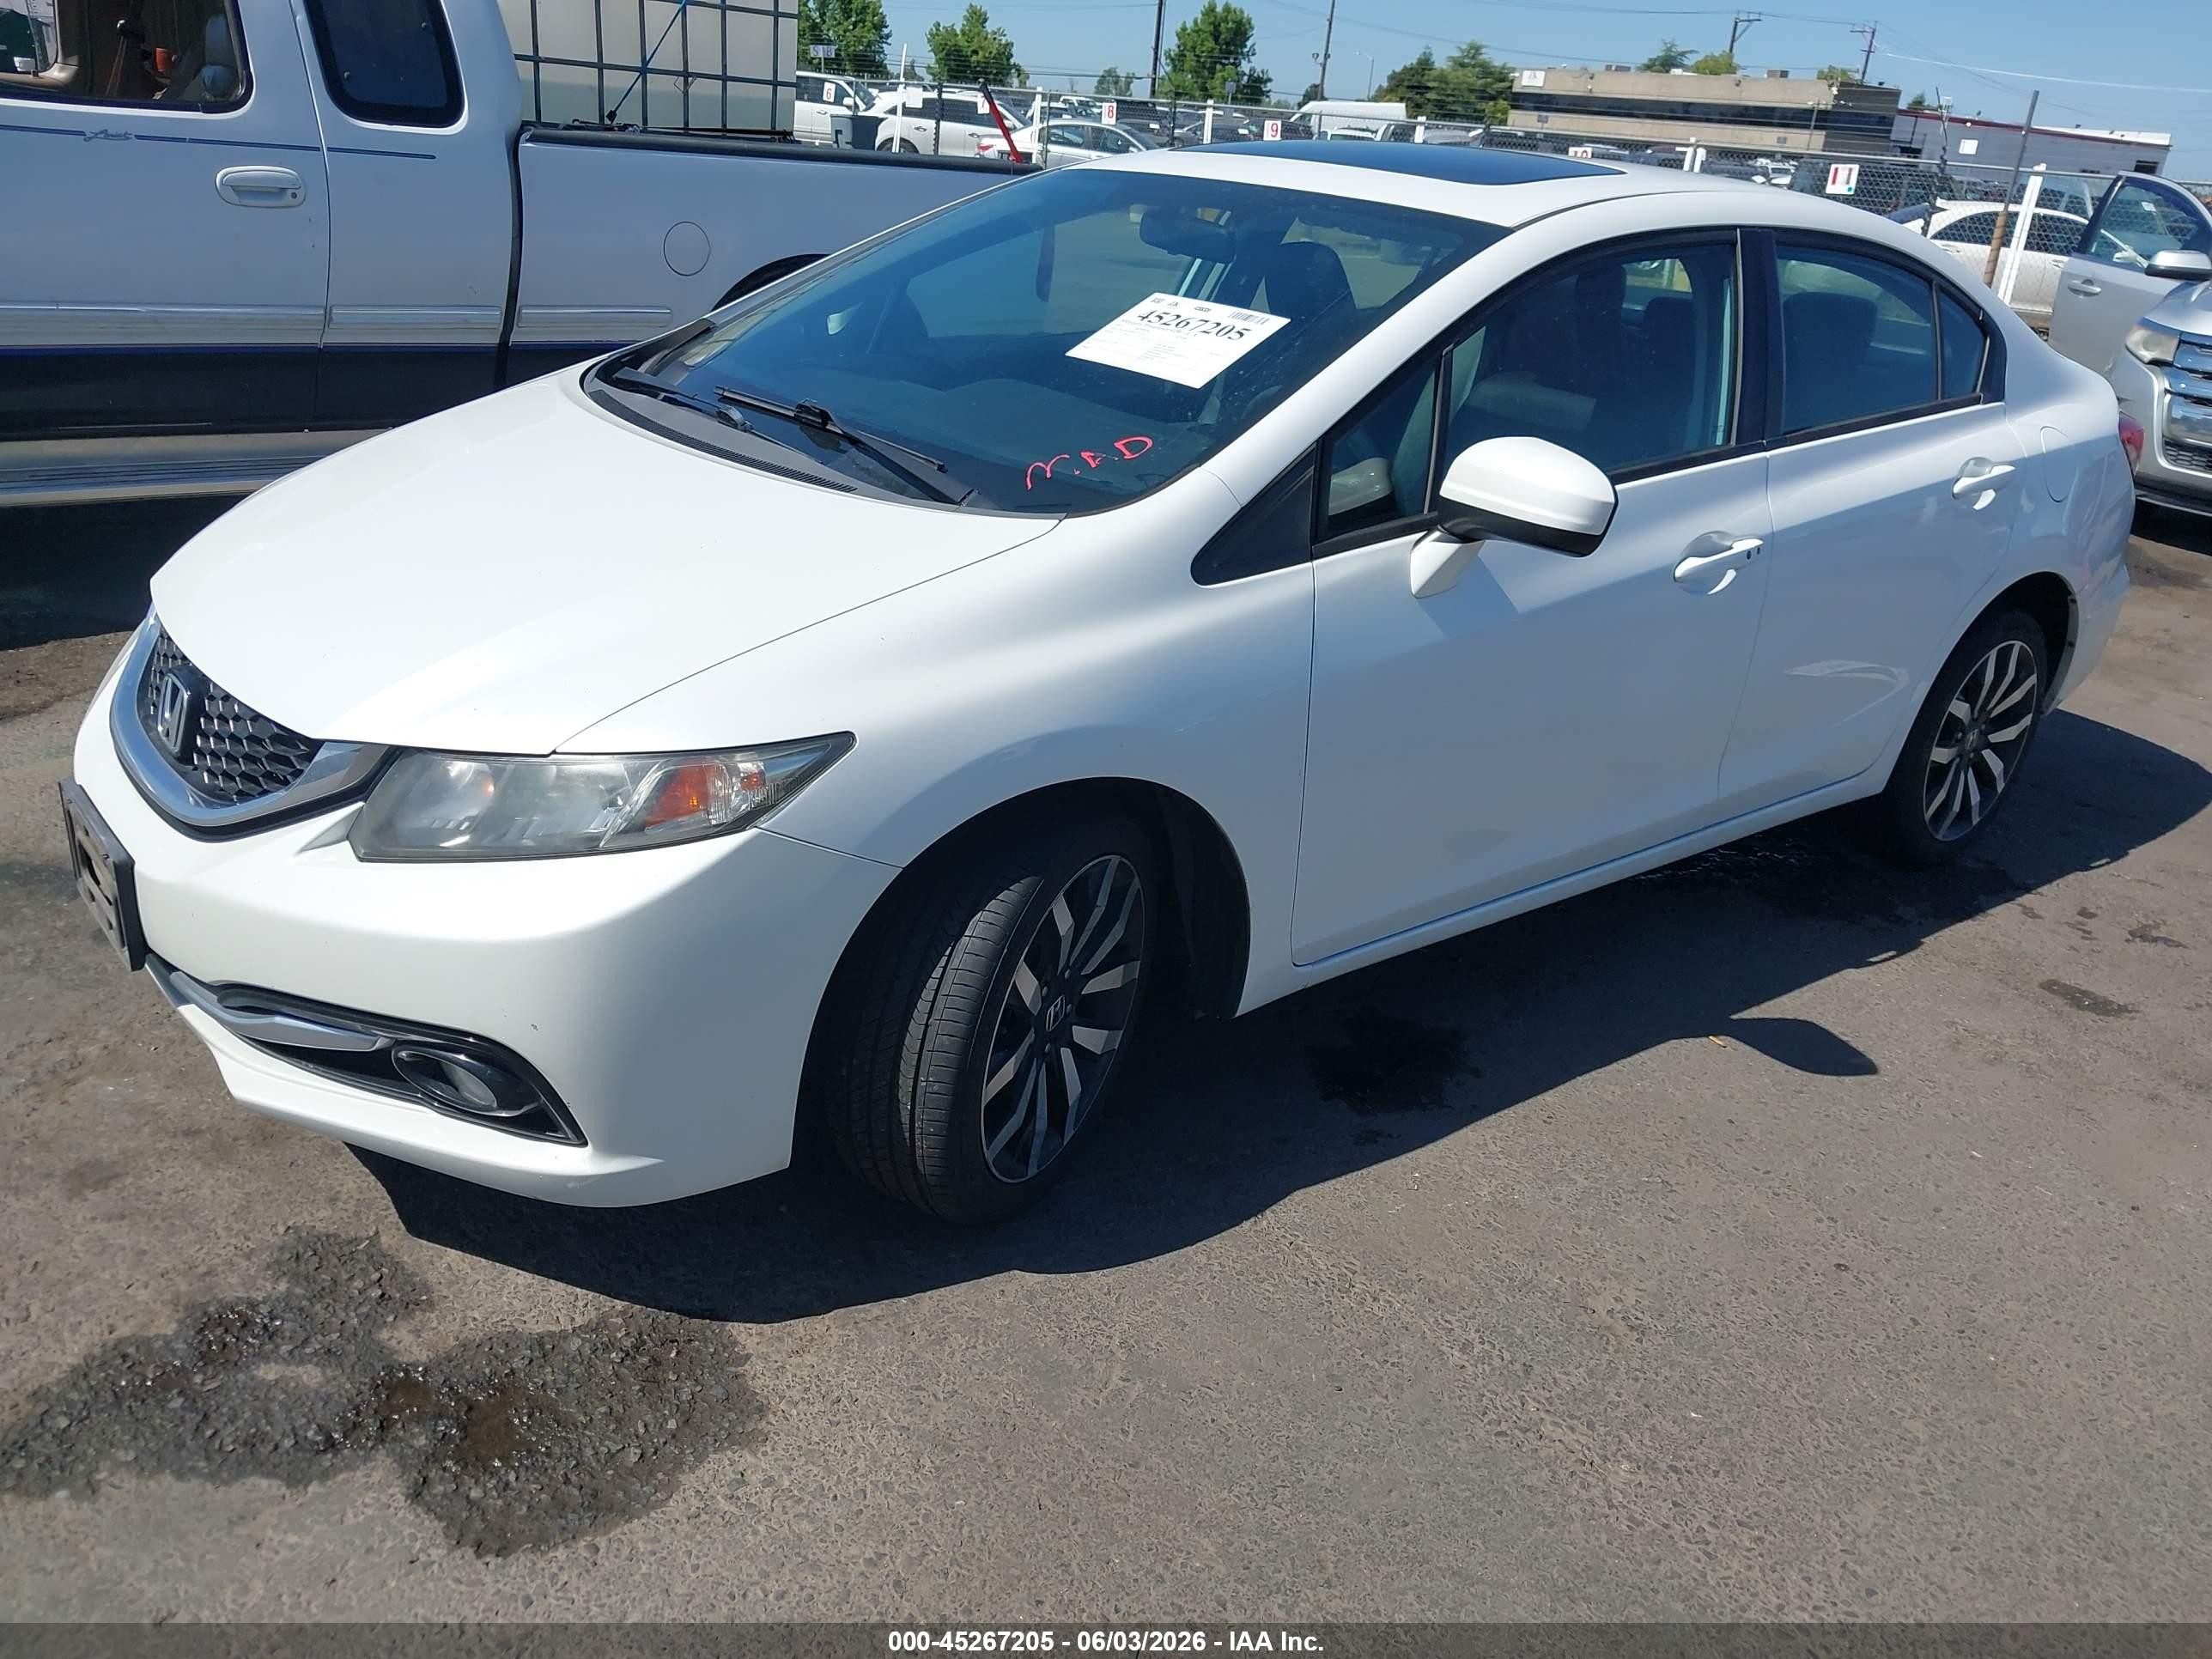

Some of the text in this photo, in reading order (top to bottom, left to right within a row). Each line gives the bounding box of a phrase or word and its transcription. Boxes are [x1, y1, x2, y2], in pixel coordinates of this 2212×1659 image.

[826, 88, 832, 100] 6
[1107, 105, 1115, 118] 8
[1271, 123, 1279, 137] 9
[1137, 309, 1251, 341] 45267205
